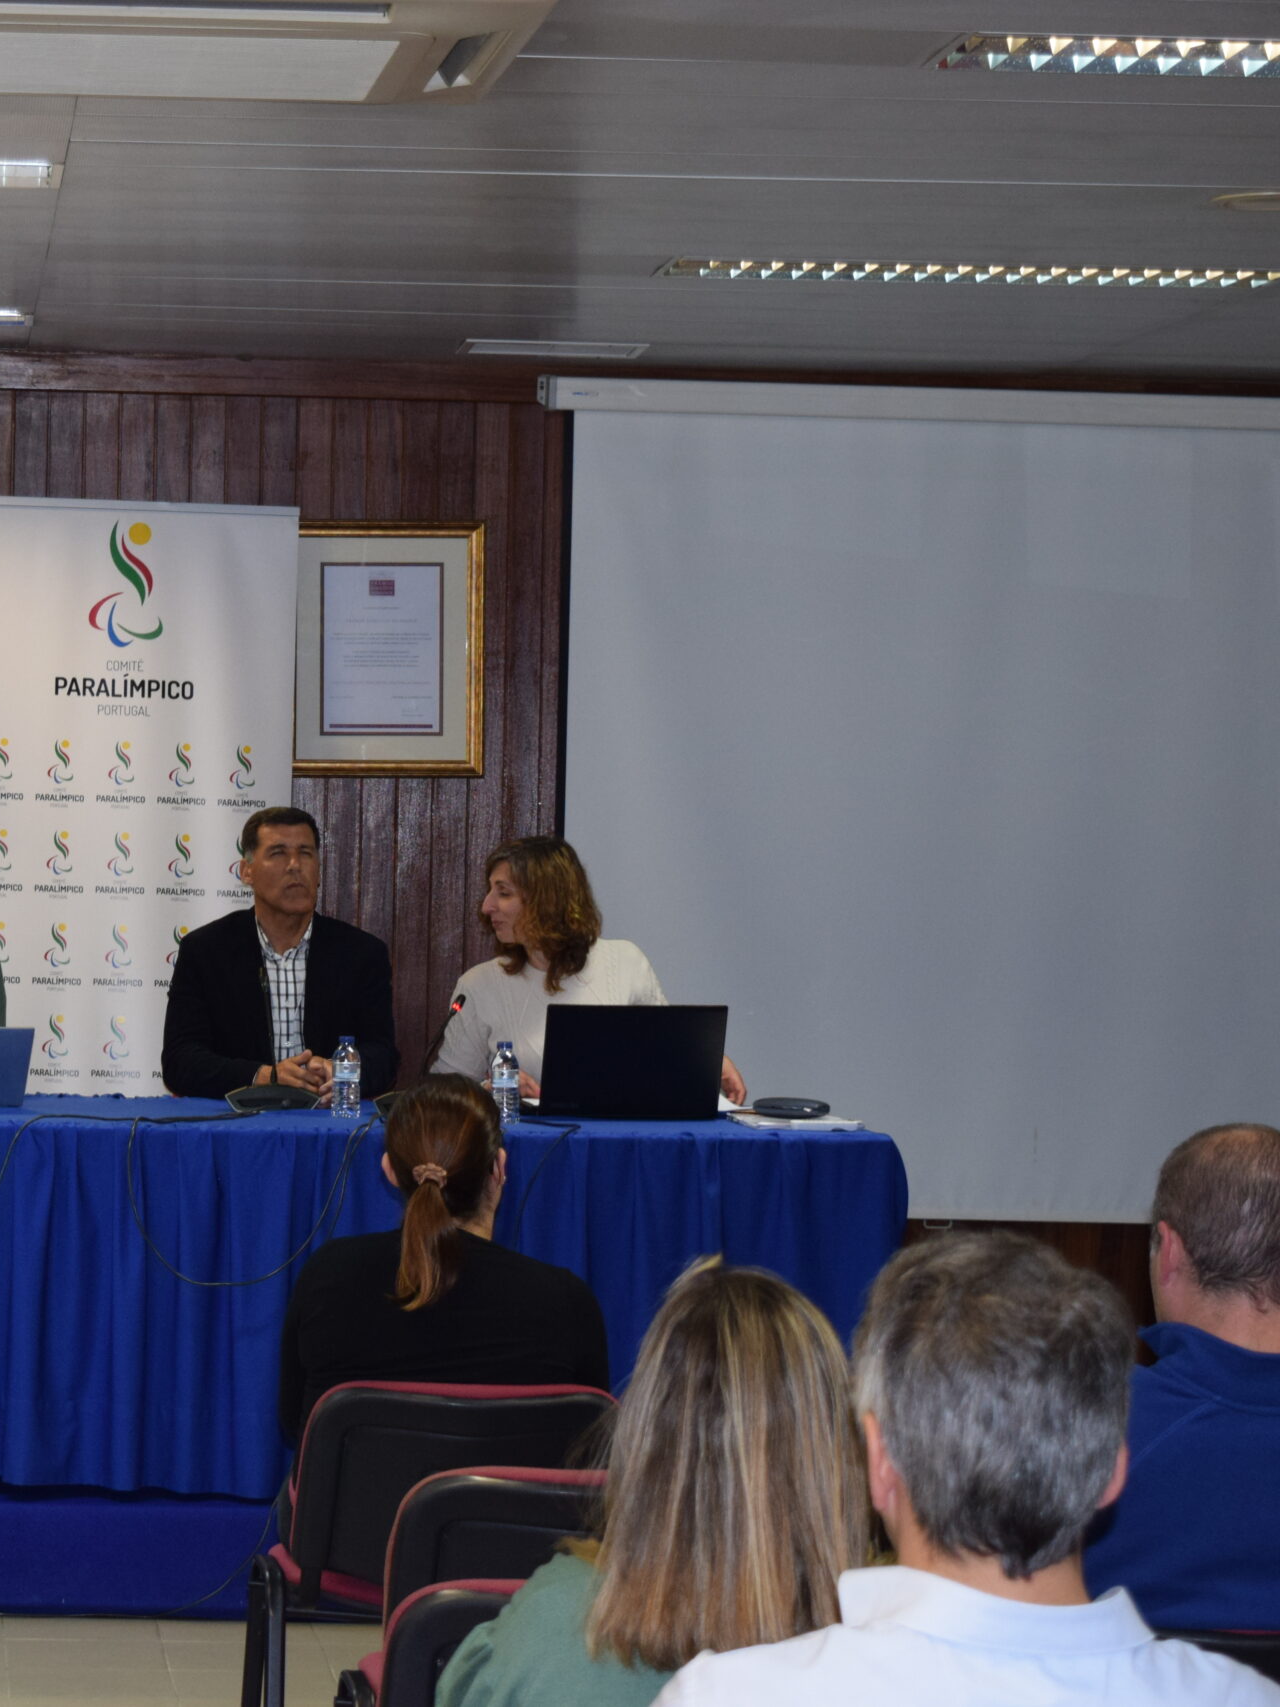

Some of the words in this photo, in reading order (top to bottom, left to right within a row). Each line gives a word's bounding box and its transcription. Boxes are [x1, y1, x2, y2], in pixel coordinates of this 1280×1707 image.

[106, 659, 144, 673] COMITÉ
[54, 674, 194, 700] PARALÍMPICO
[97, 704, 151, 717] PORTUGAL
[35, 793, 85, 802] PARALÍMPICO
[95, 794, 146, 804] PARALÍMPICO
[156, 796, 206, 806] PARALÍMPICO
[217, 797, 266, 808] PARALÍMPICO
[34, 883, 84, 893] PARALÍMPICO
[95, 885, 145, 895] PARALÍMPICO
[156, 886, 205, 897] PARALÍMPICO
[32, 975, 81, 986] PARALÍMPICO
[93, 977, 143, 988] PARALÍMPICO
[30, 1067, 80, 1078] PARALÍMPICO
